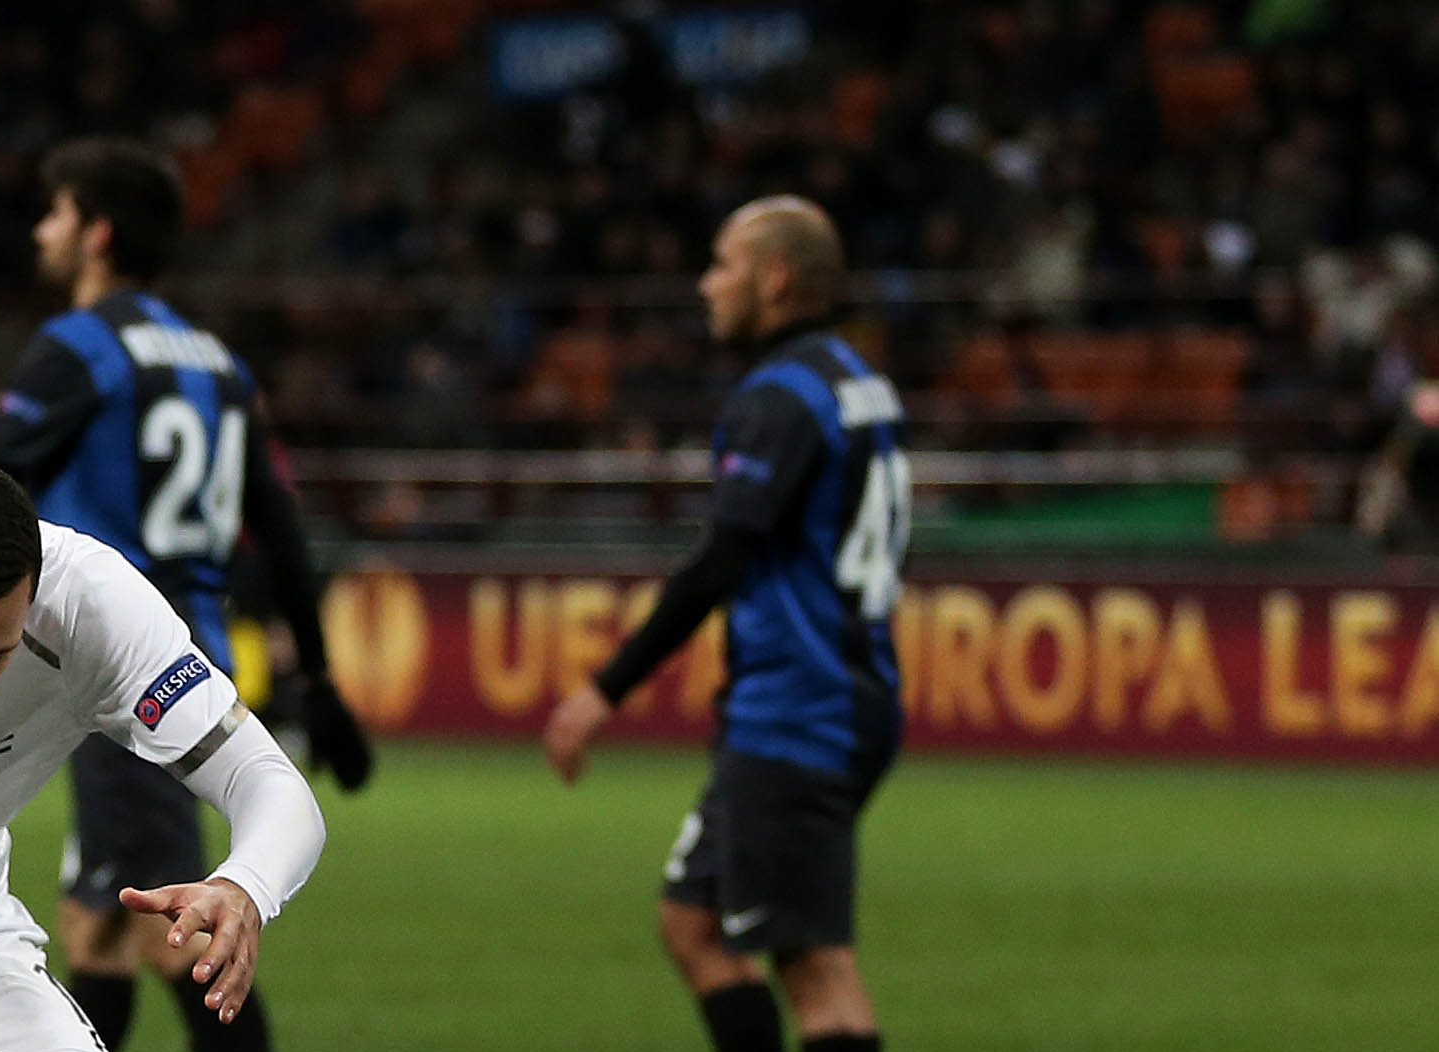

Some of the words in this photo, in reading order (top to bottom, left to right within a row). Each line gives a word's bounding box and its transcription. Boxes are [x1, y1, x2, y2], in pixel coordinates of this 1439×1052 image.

[139, 396, 246, 562] 24
[154, 659, 207, 703] RESPECT
[893, 585, 1236, 736] ROPA
